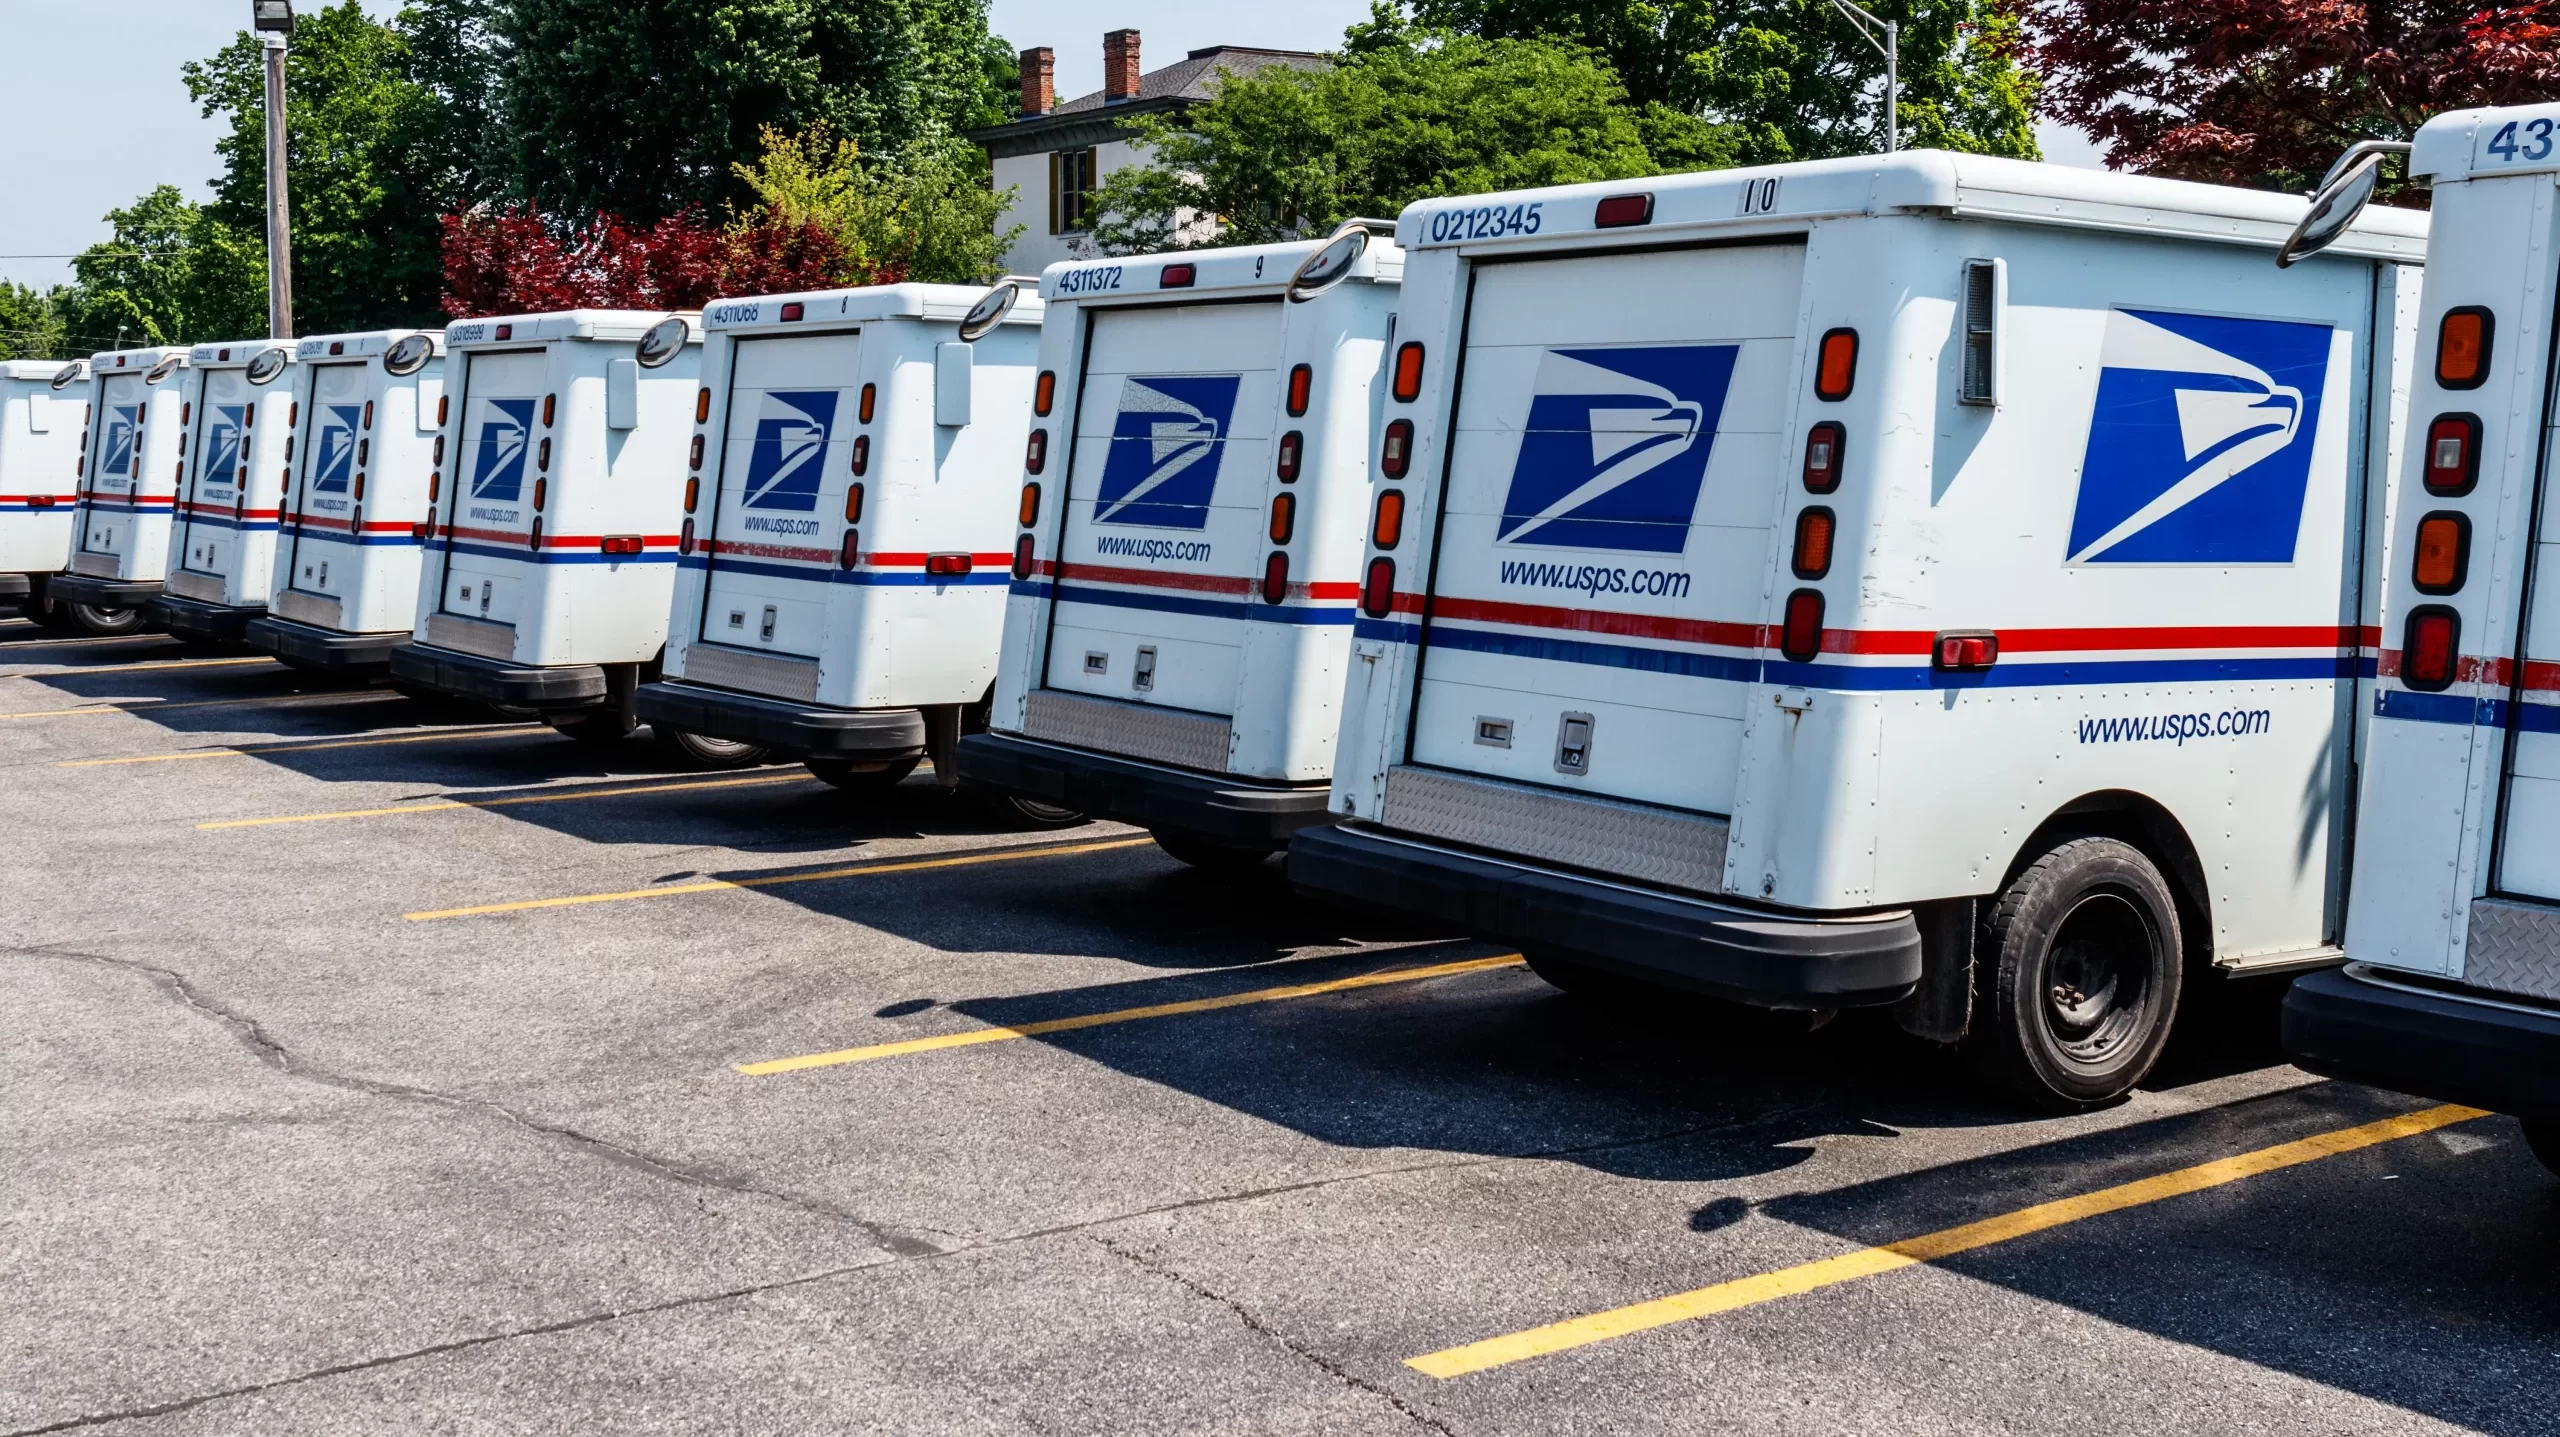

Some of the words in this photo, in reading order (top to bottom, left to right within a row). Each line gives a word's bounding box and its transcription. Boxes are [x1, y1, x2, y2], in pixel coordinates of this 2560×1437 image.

[2487, 118, 2560, 161] 43
[1744, 178, 1776, 213] 10
[1432, 203, 1543, 242] 0212345
[1059, 265, 1122, 293] 4311372
[1254, 255, 1264, 279] 9
[714, 303, 760, 323] 4311068
[841, 295, 848, 314] 8
[313, 498, 348, 514] www.usps.com
[470, 506, 520, 524] www.usps.com
[744, 516, 820, 538] www.usps.com
[1097, 536, 1211, 563] www.usps.com
[1501, 561, 1691, 598] www.usps.com
[2079, 709, 2270, 747] www.usps.com
